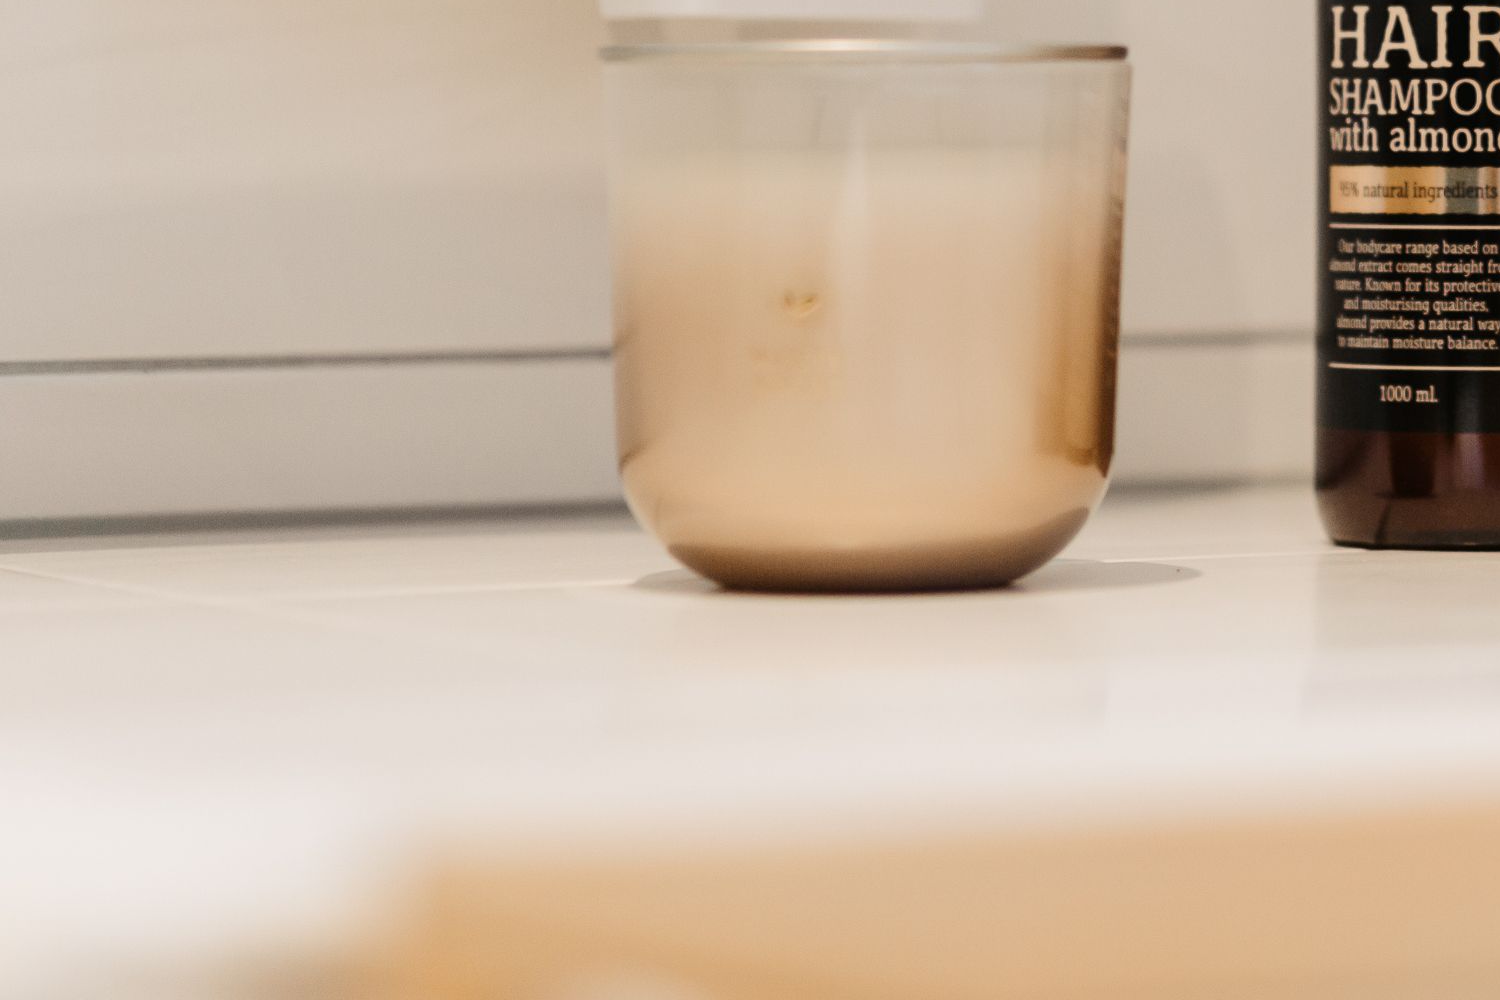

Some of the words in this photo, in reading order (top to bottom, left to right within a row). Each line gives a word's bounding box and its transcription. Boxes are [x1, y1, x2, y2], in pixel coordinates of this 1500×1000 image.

[1329, 117, 1379, 152] with
[1363, 180, 1409, 199] natural
[1413, 181, 1499, 202] ingredients
[1356, 238, 1402, 258] bodycare
[1405, 243, 1439, 258] range
[1442, 239, 1479, 255] based
[1482, 243, 1499, 255] on
[1358, 260, 1393, 273] extract
[1395, 261, 1432, 274] comes
[1435, 259, 1484, 277] straight
[1364, 277, 1401, 292] Known
[1405, 277, 1422, 292] for
[1425, 278, 1440, 293] its
[1343, 296, 1359, 310] and
[1361, 296, 1430, 315] moisturising
[1336, 314, 1367, 329] almond
[1369, 315, 1415, 333] provides
[1418, 319, 1425, 330] a
[1428, 316, 1473, 331] natural
[1347, 333, 1389, 349] maintain
[1392, 335, 1444, 350] moisture
[1446, 335, 1498, 350] balance.
[1380, 385, 1412, 402] 1000
